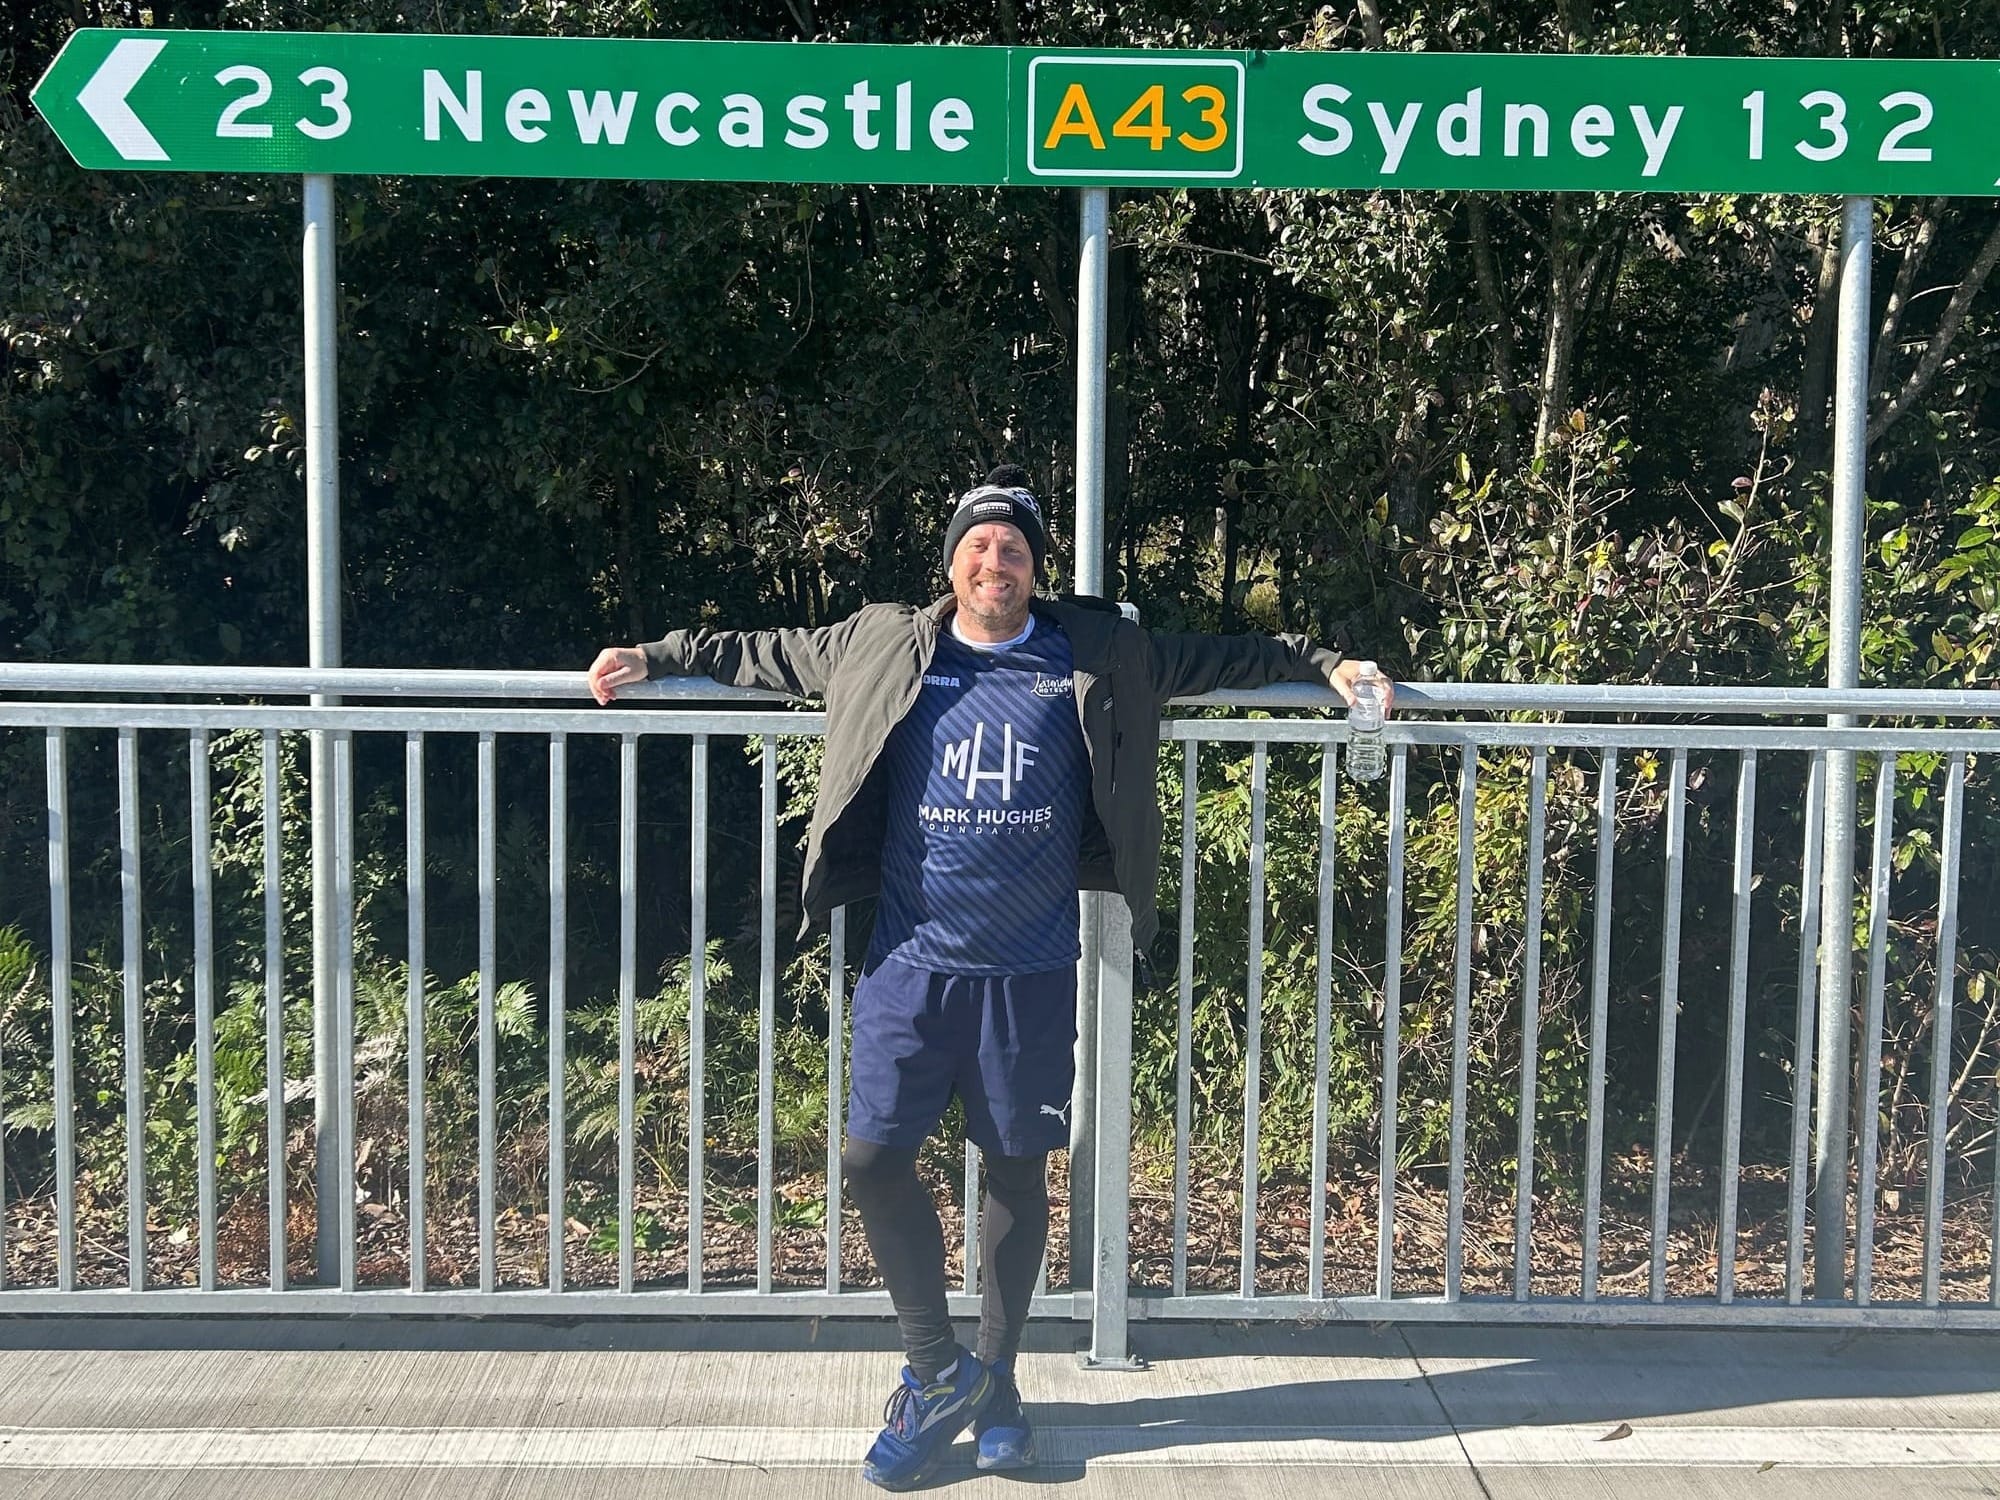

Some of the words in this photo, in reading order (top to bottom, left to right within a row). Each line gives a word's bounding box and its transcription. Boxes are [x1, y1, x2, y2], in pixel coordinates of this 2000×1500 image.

[214, 64, 352, 140] 23
[423, 69, 975, 153] Newcastle
[1044, 84, 1228, 152] A43
[1297, 83, 1684, 177] Sydney
[1742, 90, 1934, 162] 132
[941, 721, 1039, 801] MHF
[918, 804, 971, 824] MARK
[977, 805, 1052, 825] HUGHES
[918, 820, 1051, 835] FOUNDATION
